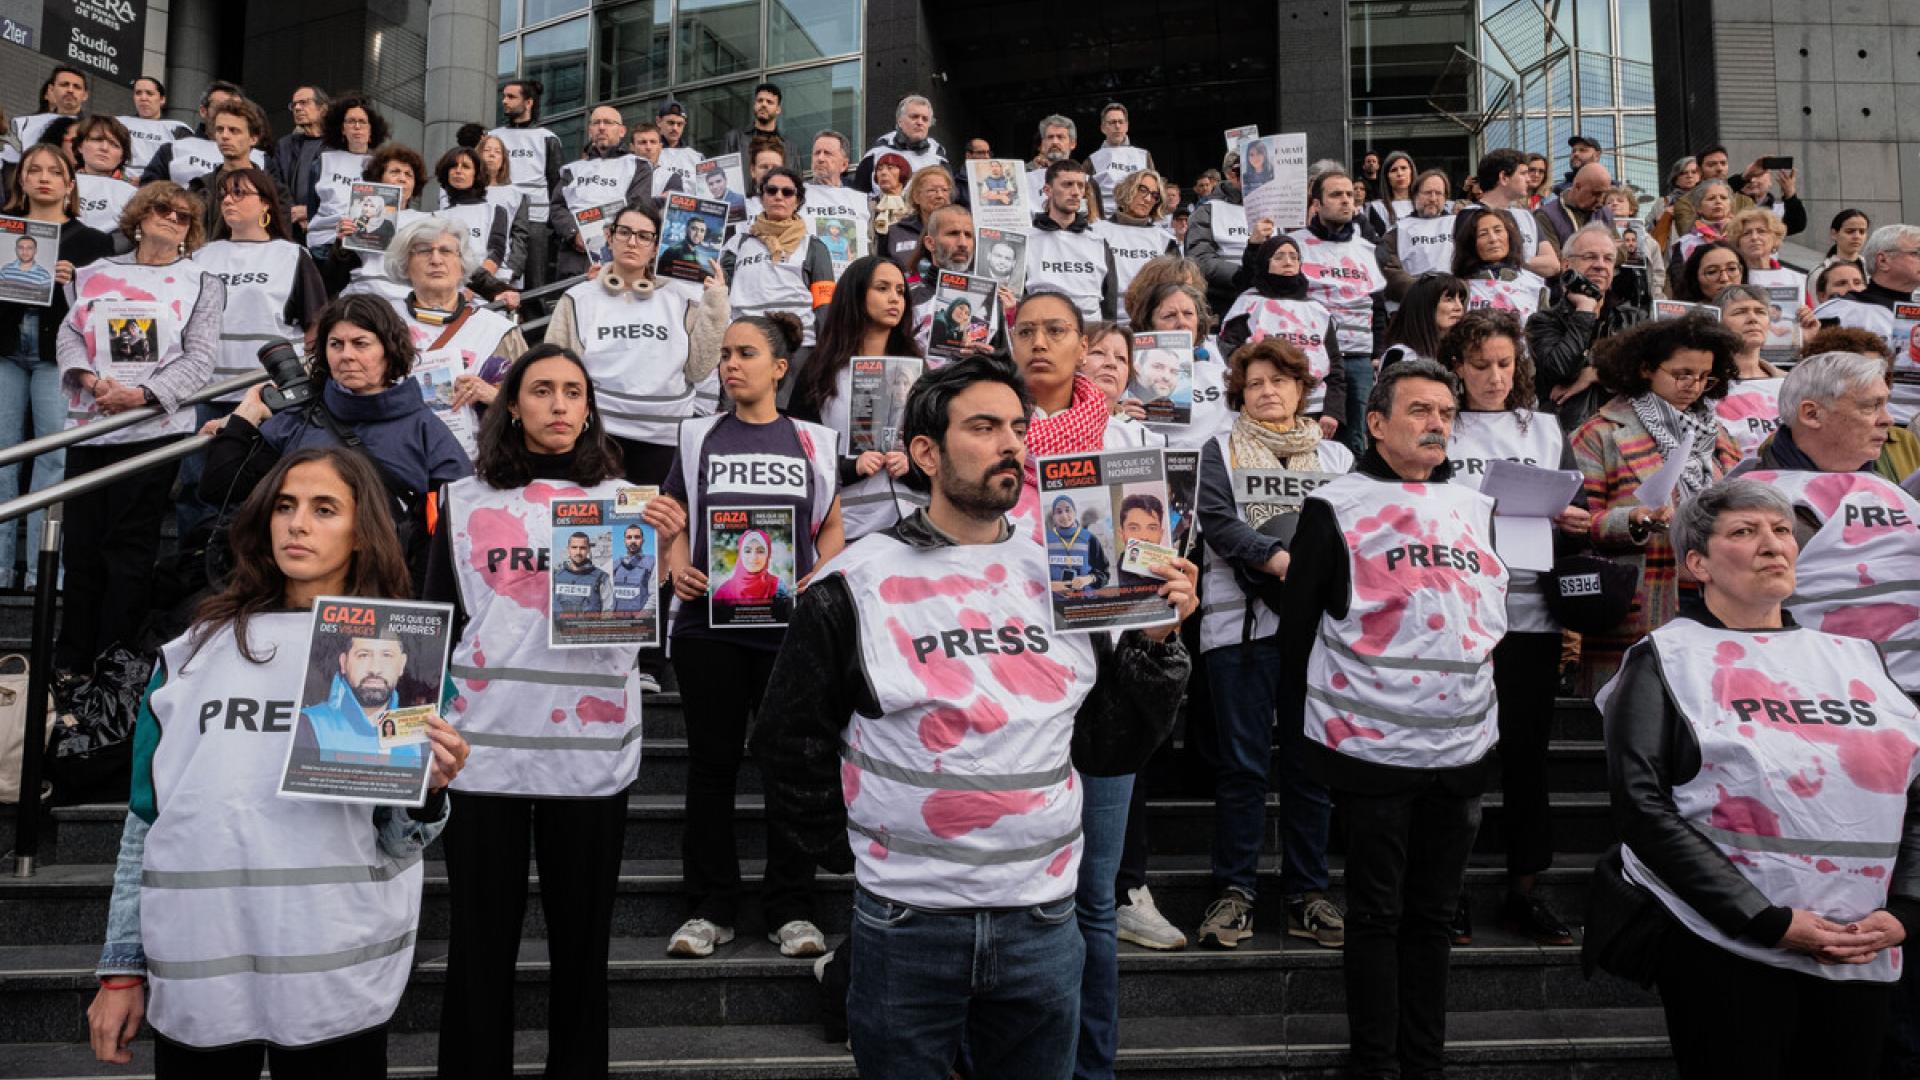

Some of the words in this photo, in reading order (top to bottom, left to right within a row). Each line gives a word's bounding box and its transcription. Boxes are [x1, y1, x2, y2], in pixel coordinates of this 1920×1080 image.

[75, 6, 89, 17] DE
[91, 13, 120, 31] PARIS
[71, 27, 118, 56] Studio
[68, 43, 118, 75] Bastille
[129, 130, 162, 141] RESS
[510, 149, 534, 158] ESS
[79, 197, 107, 211] ESS
[807, 205, 858, 216] PRESS
[1111, 247, 1158, 259] PRESS
[1042, 261, 1095, 274] PRESS
[217, 272, 269, 286] RESS
[597, 323, 668, 341] PRESS
[1747, 417, 1785, 433] PRE
[711, 461, 804, 487] PRESS
[1045, 459, 1097, 479] GAZA
[1108, 466, 1152, 477] NOMBRES
[1046, 480, 1063, 488] DES
[1247, 475, 1331, 497] PRES
[556, 503, 599, 517] GAZA
[714, 511, 748, 523] GAZA
[1845, 503, 1920, 530] PRE
[487, 547, 550, 573] PRE
[1386, 544, 1480, 574] PRESS
[1561, 574, 1600, 594] PRESS
[322, 604, 376, 626] GAZA
[389, 613, 406, 622] PAS
[407, 615, 424, 625] QUE
[425, 616, 442, 626] DES
[320, 622, 338, 634] DES
[912, 625, 1049, 664] PRESS
[199, 697, 295, 735] PRE
[1731, 698, 1877, 726] PRESS
